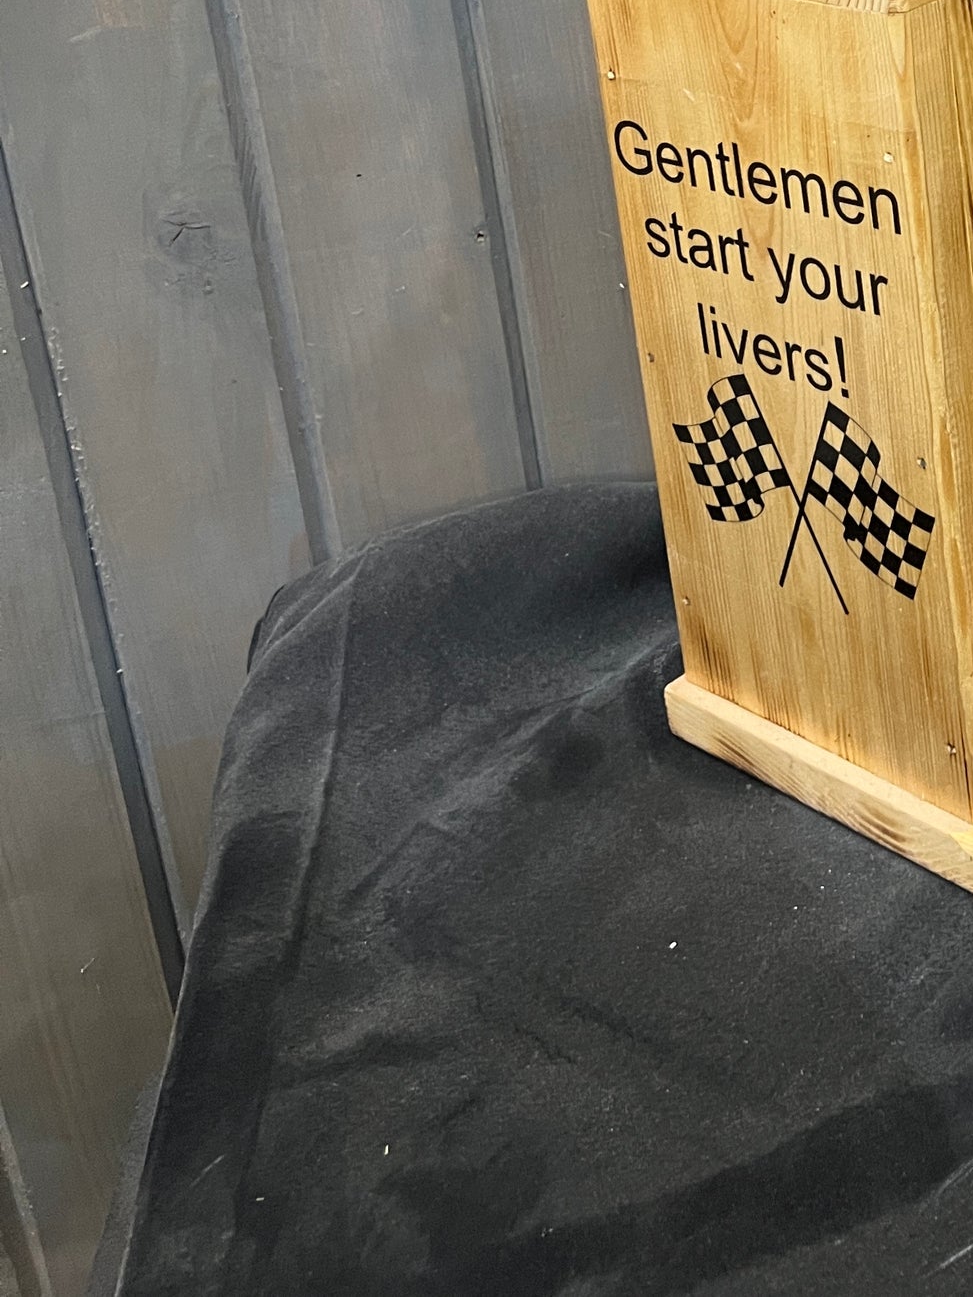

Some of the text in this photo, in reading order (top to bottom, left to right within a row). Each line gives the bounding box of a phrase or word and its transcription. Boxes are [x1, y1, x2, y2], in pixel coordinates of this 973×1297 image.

[614, 120, 902, 235] Gentlemen
[645, 212, 888, 316] start your
[697, 302, 850, 399] livers!
